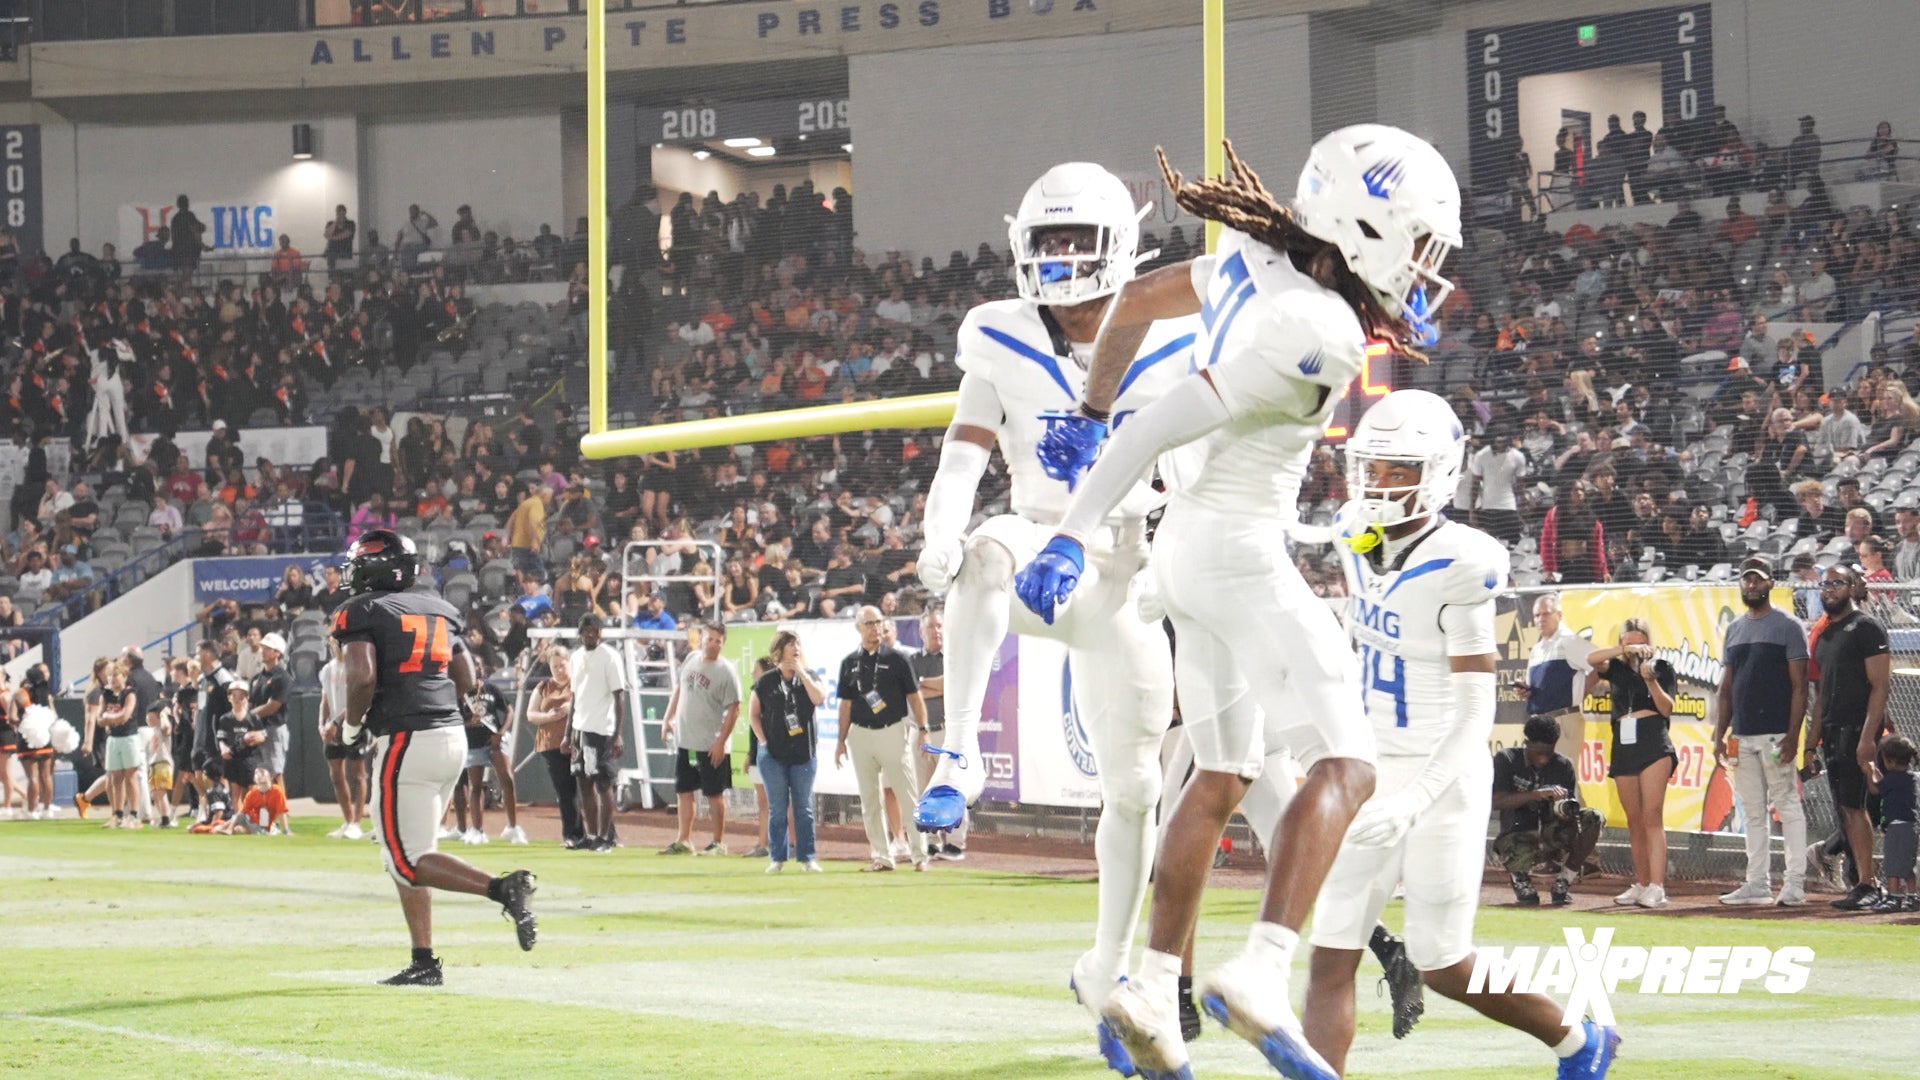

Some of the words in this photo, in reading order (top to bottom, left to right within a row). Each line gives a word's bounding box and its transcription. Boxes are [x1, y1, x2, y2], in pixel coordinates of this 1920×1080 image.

[310, 31, 495, 65] ALLEN
[543, 18, 687, 52] PTE
[757, 1, 940, 38] PRESS
[1483, 33, 1502, 139] 209
[1678, 11, 1697, 120] 210
[662, 108, 716, 140] 208
[798, 100, 851, 132] 209
[5, 131, 25, 227] 208
[211, 205, 274, 249] IMG
[200, 577, 270, 592] WELCOME
[398, 614, 453, 673] 74
[1672, 693, 1705, 719] bing
